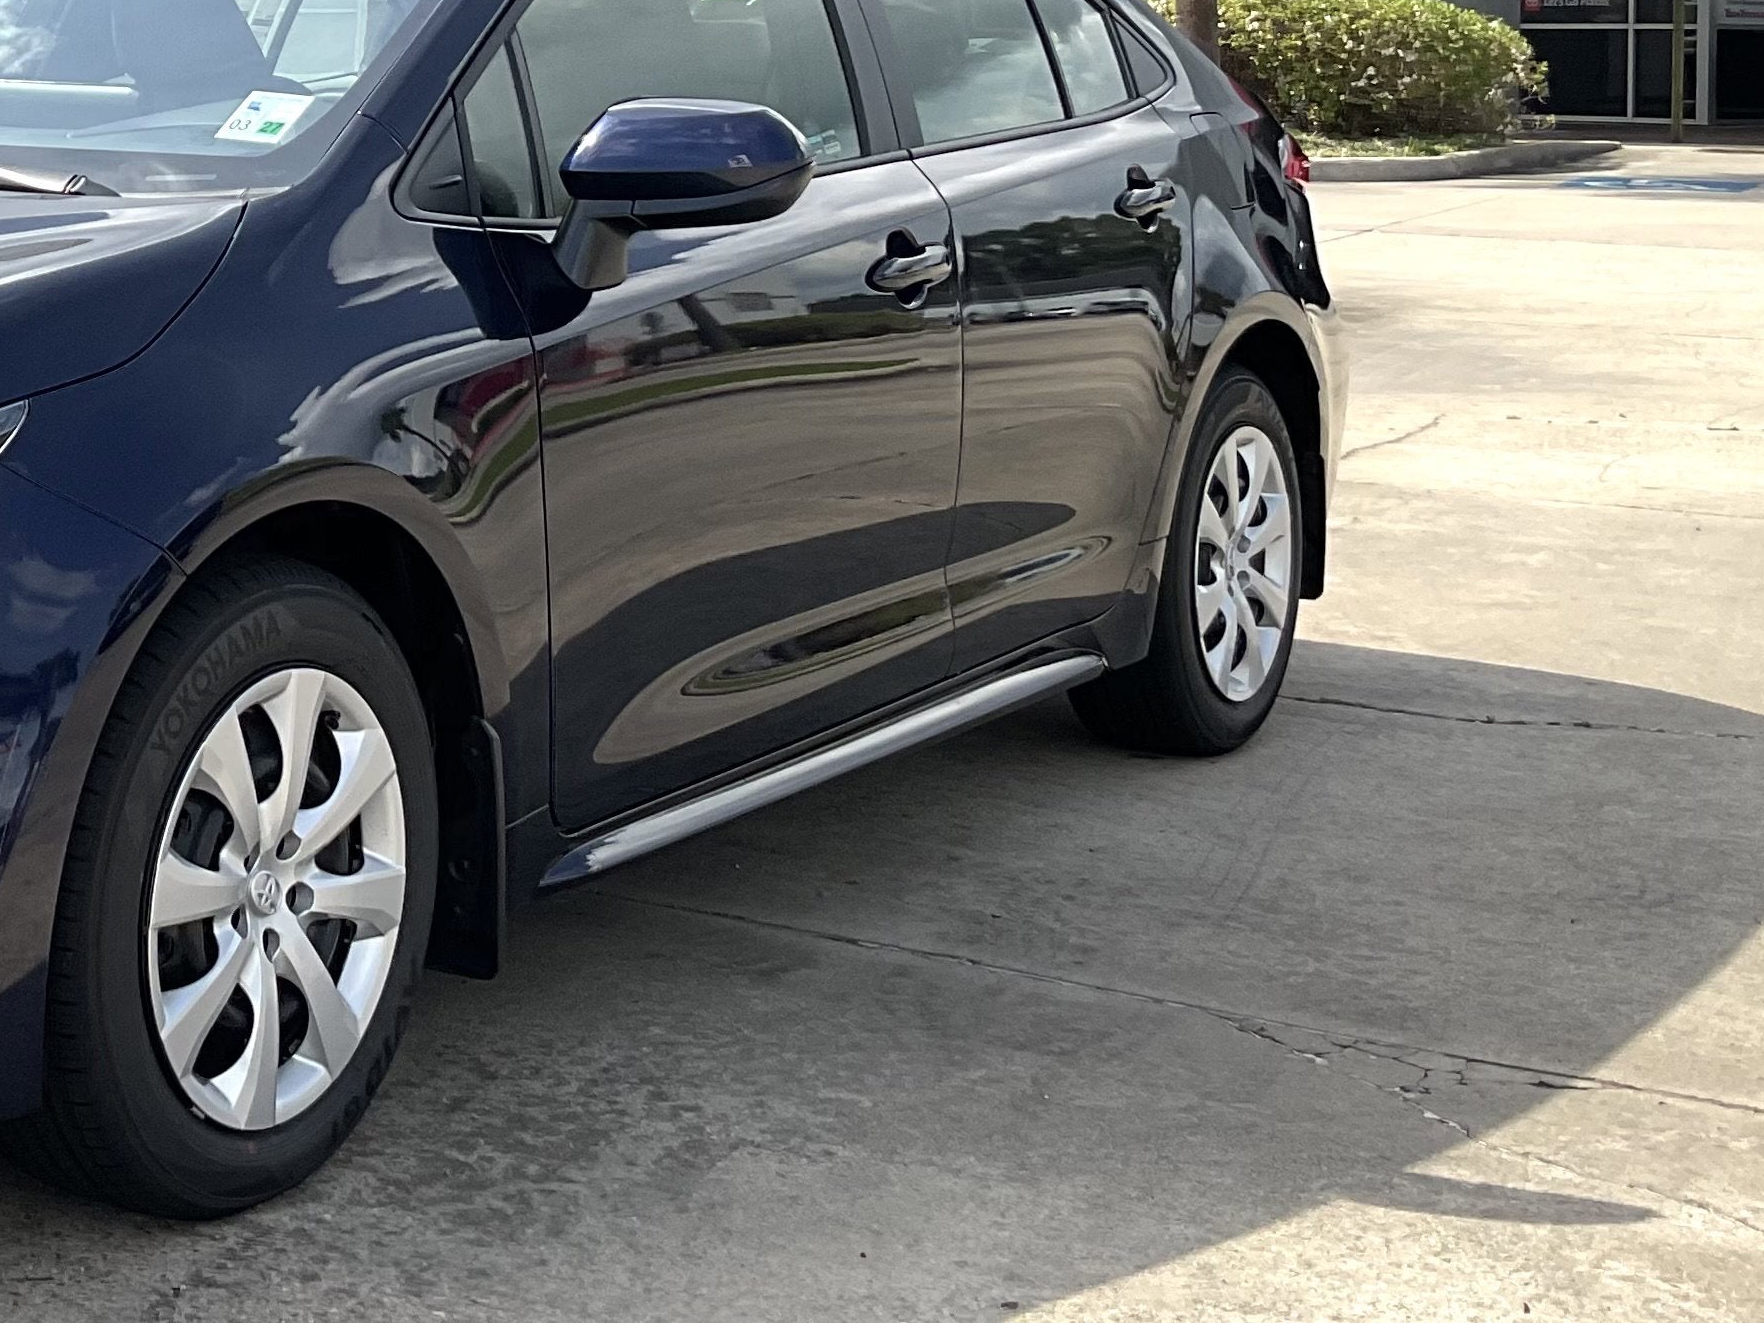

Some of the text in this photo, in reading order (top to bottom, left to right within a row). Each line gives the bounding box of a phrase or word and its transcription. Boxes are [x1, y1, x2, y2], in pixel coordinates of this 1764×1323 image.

[228, 118, 286, 134] 03 27
[148, 608, 282, 754] YOKOHAMA
